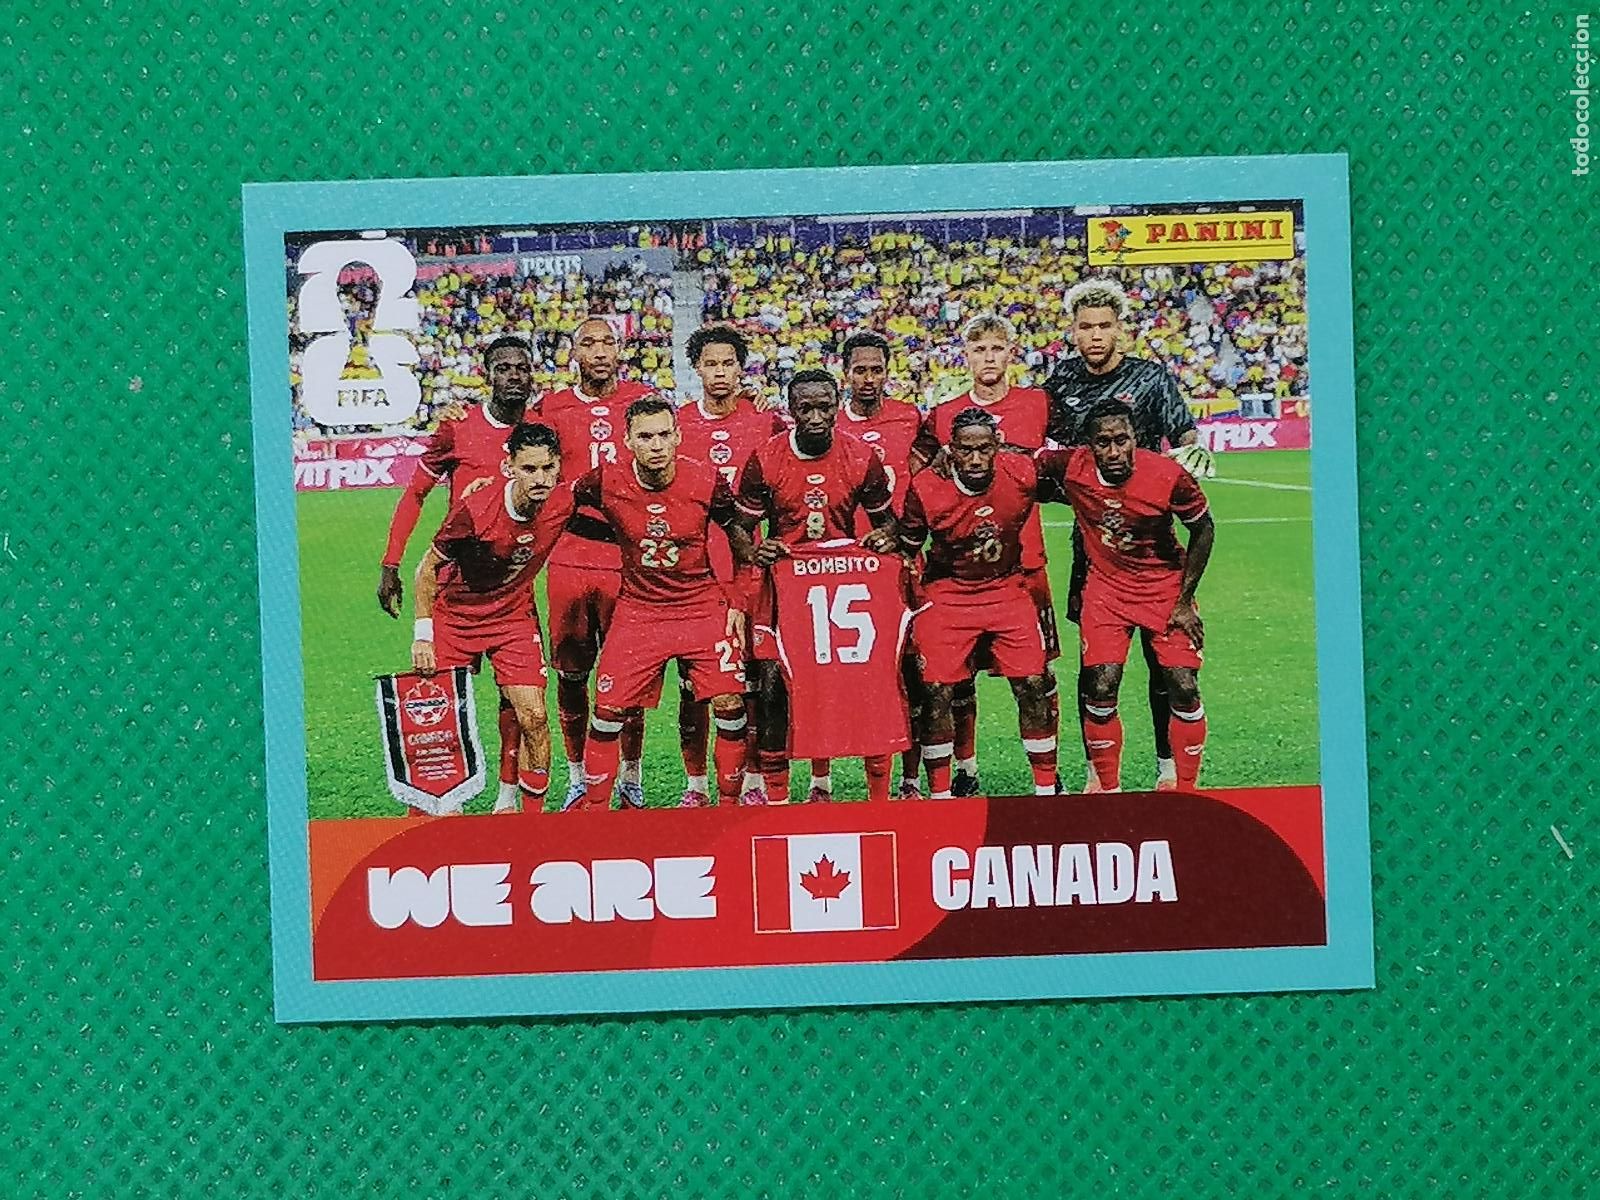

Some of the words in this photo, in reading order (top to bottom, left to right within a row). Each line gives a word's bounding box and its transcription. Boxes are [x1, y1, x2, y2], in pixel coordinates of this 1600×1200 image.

[1145, 219, 1284, 244] PANINI
[336, 388, 391, 408] FIFA
[639, 538, 680, 568] 23
[793, 556, 881, 577] BOMBITO
[806, 583, 877, 665] 15
[368, 863, 513, 929] WE
[529, 856, 718, 924] ARE
[931, 840, 1179, 911] CANADA
